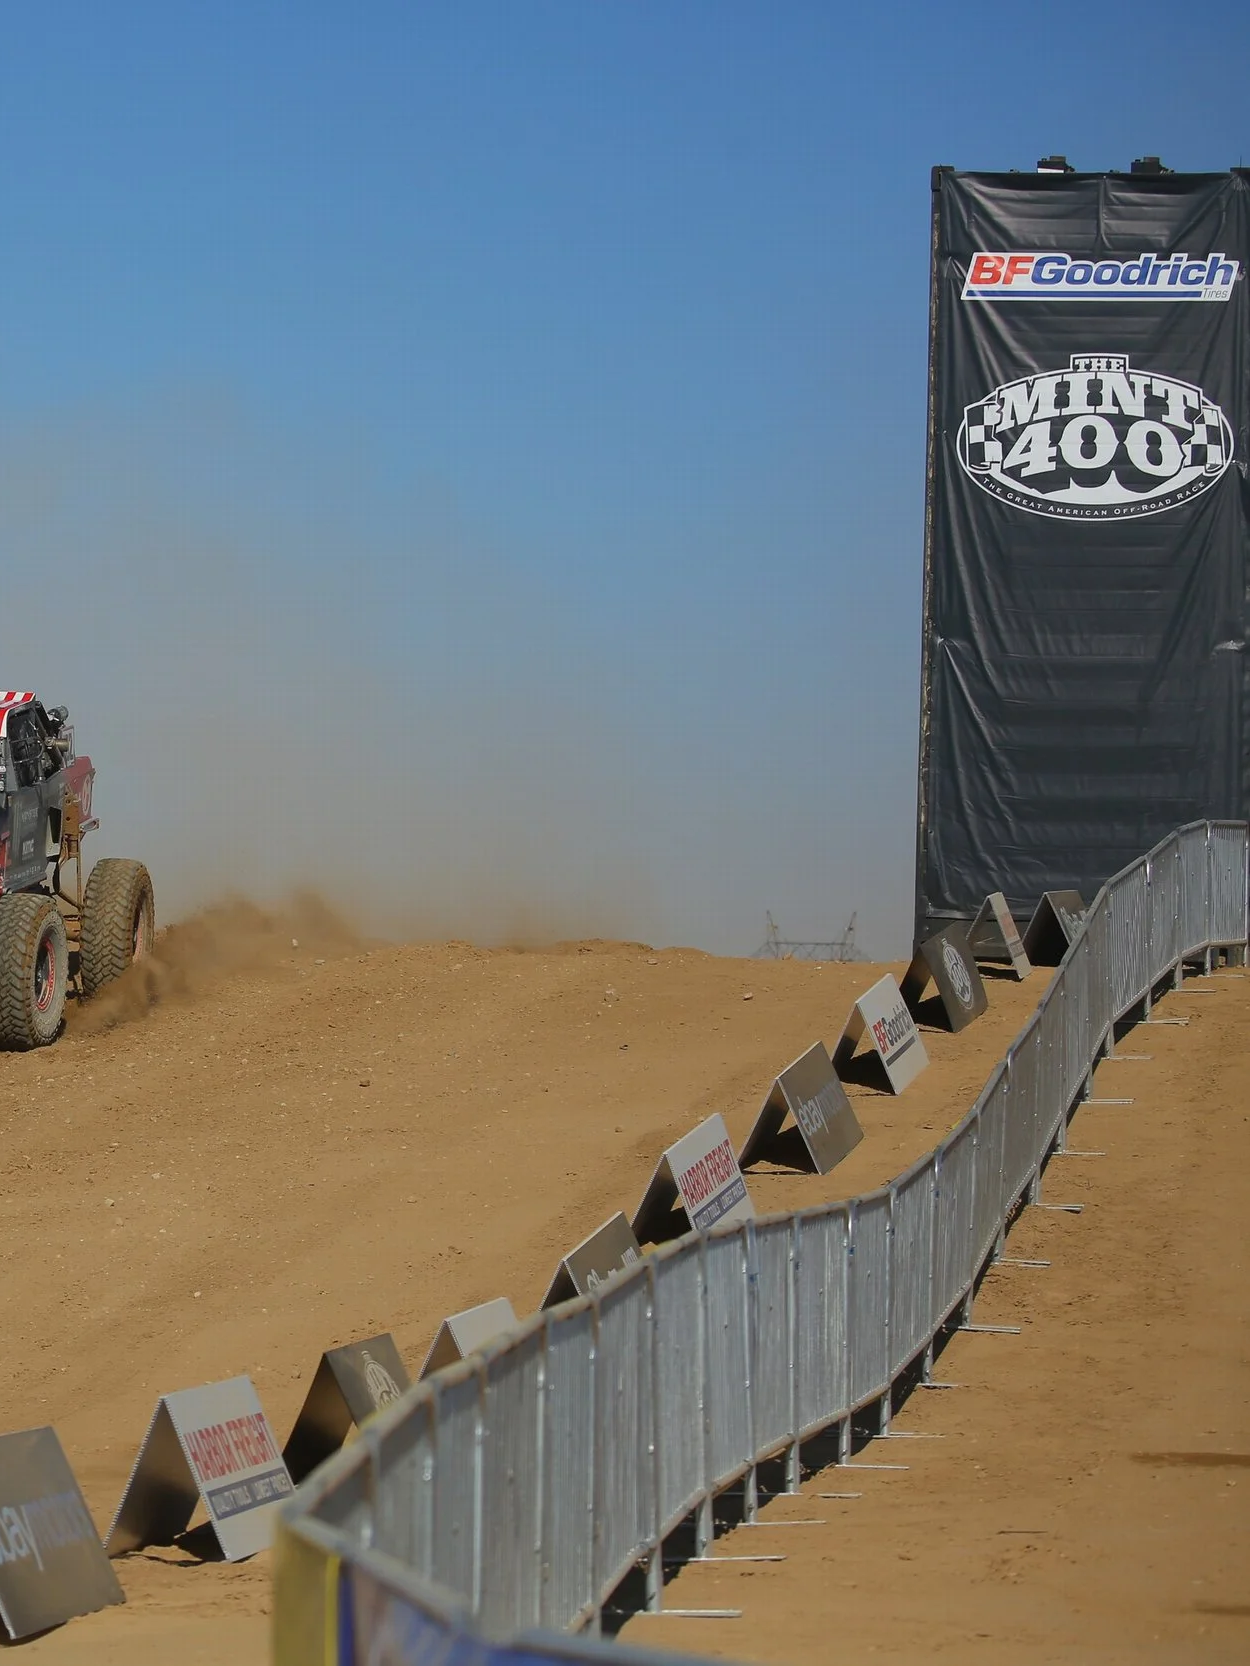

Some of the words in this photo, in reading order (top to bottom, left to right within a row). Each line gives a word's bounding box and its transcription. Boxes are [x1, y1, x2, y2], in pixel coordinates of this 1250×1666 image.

[969, 255, 1234, 286] BFGoodrich
[1202, 287, 1228, 299] Tires
[1074, 359, 1124, 371] THE
[995, 372, 1200, 434] MINT
[1003, 414, 1187, 478] 400
[982, 477, 1001, 494] THE
[1007, 492, 1043, 509] GREAT
[1048, 506, 1107, 516] AMERICAN
[1177, 481, 1205, 500] RACE
[872, 1001, 913, 1054] BFGoodrich
[677, 1160, 714, 1211] HARBOR
[704, 1138, 738, 1188] FREIGHT
[183, 1424, 241, 1482] HARBOR
[225, 1412, 279, 1469] FREIGHT
